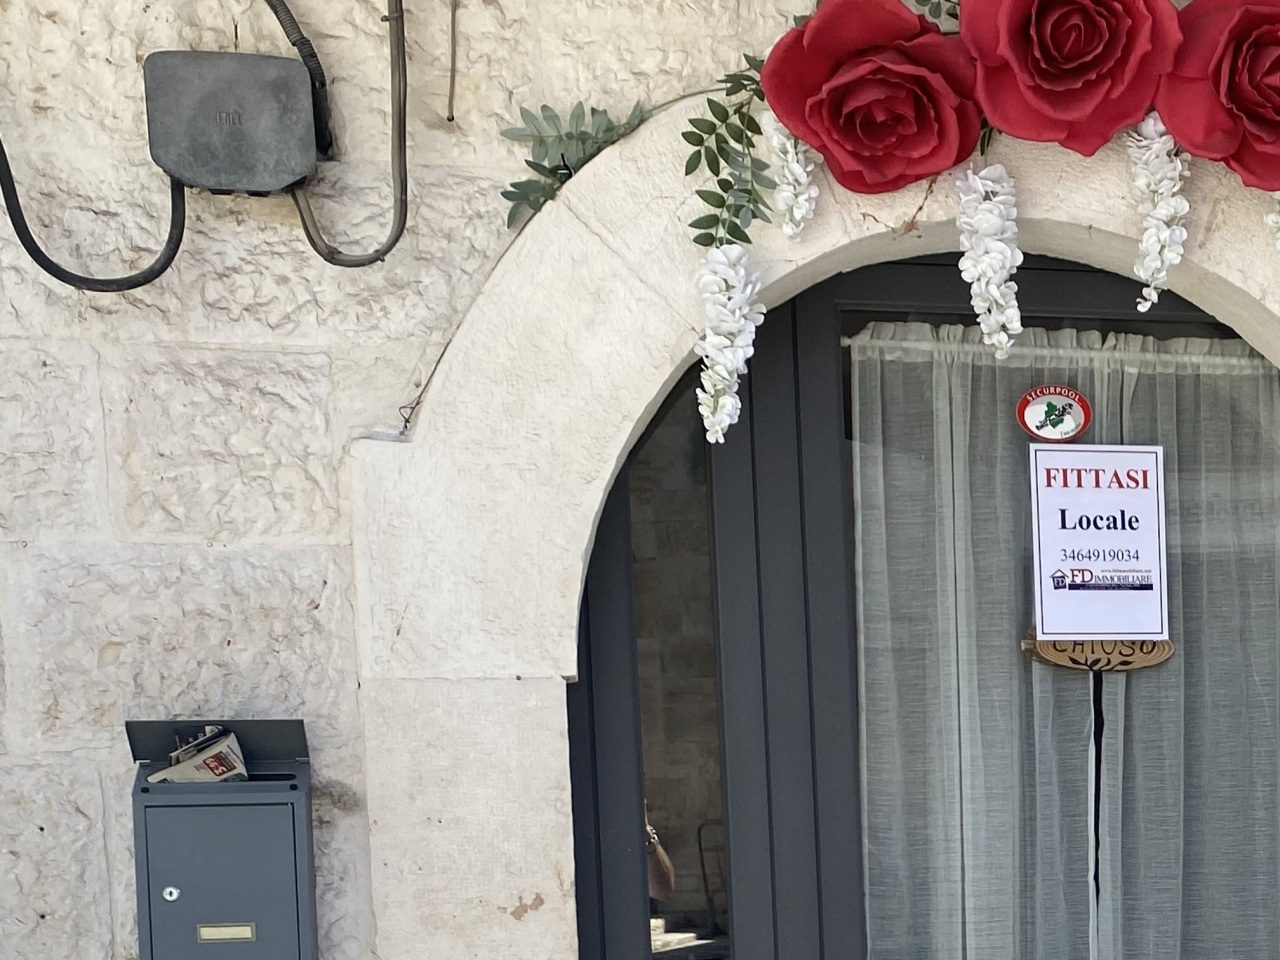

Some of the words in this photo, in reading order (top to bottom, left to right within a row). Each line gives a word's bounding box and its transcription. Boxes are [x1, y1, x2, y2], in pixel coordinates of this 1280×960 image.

[1026, 386, 1081, 402] SECURPOOL
[1044, 467, 1150, 489] FITTASI
[1058, 508, 1140, 531] Locale
[1060, 549, 1140, 562] 3464919034
[1070, 568, 1093, 583] FD
[1094, 574, 1152, 584] IMMOBILIARE
[1053, 640, 1157, 657] CHIUSO
